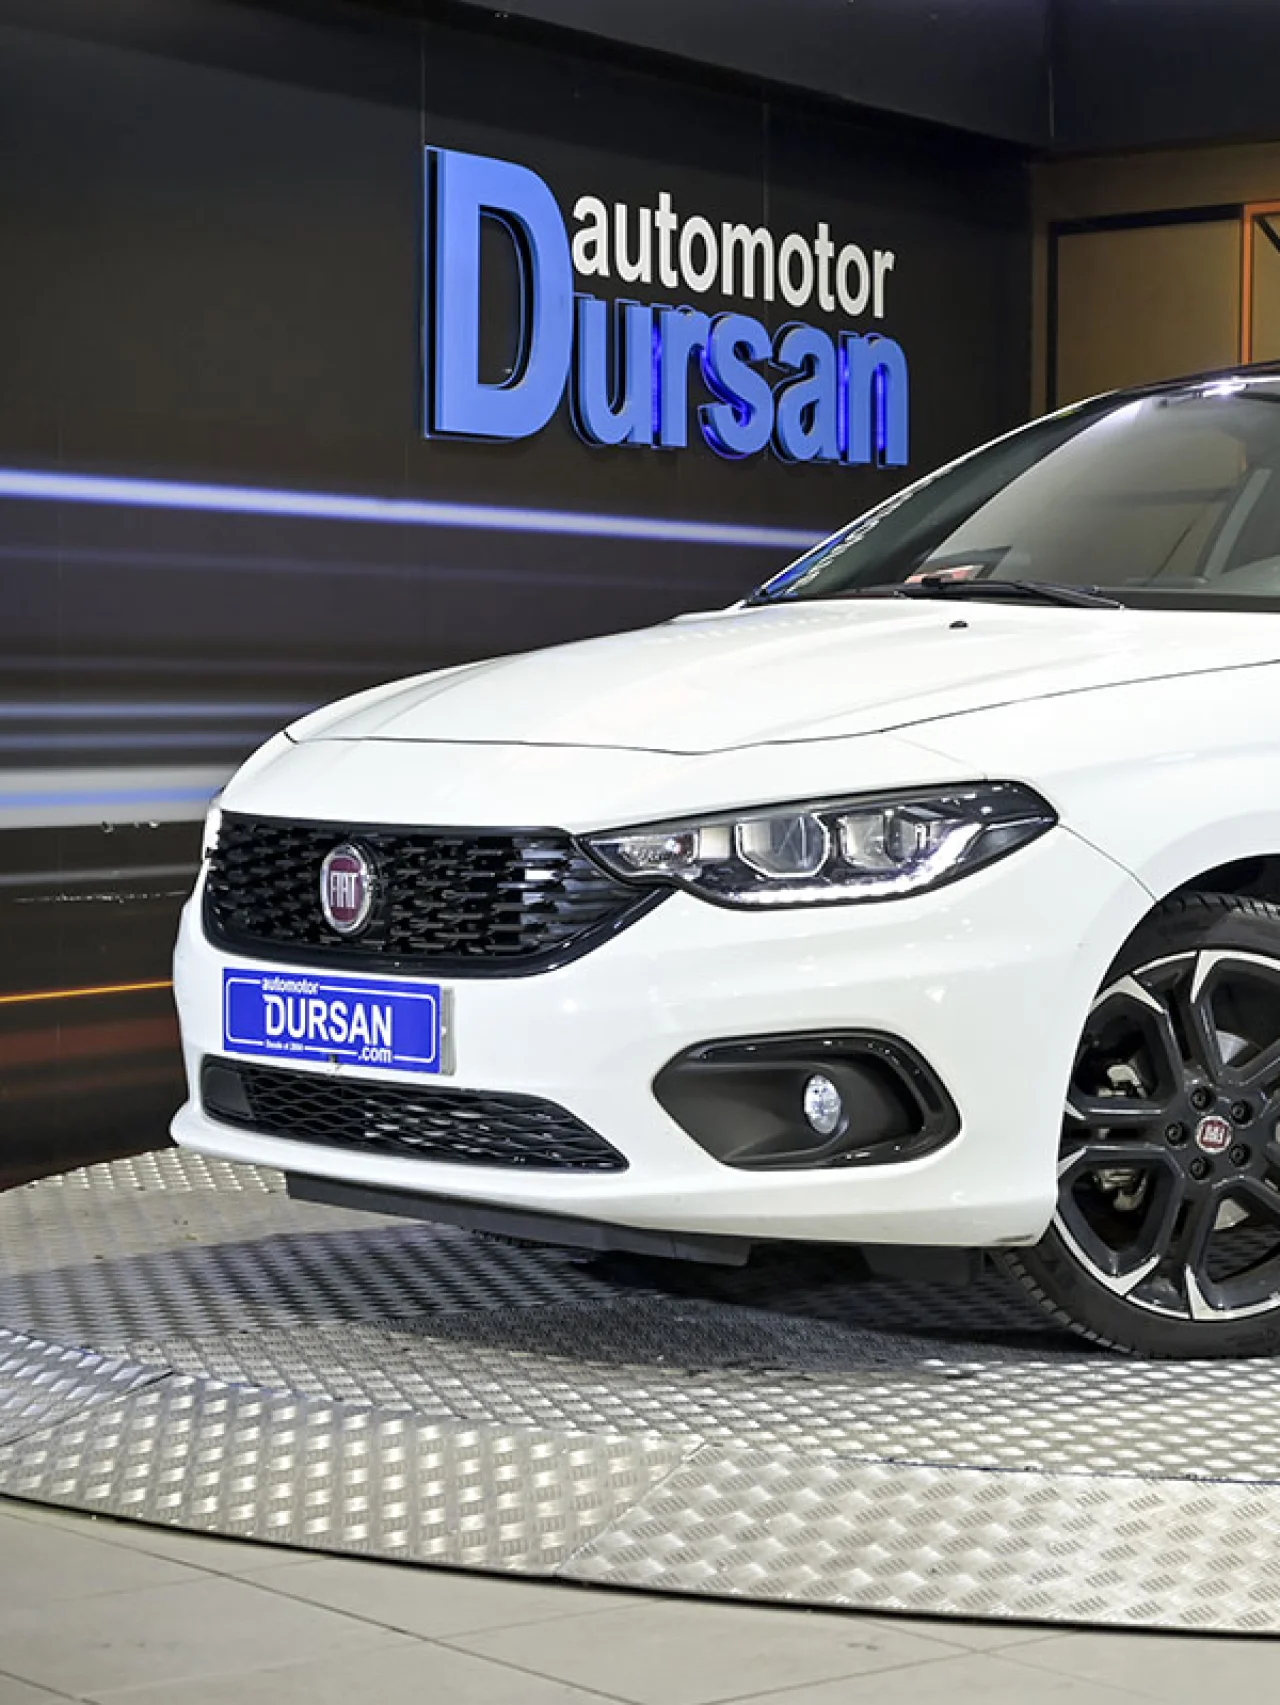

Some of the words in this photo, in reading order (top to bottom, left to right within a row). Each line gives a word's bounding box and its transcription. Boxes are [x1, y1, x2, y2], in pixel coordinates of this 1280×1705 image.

[571, 191, 895, 318] automotor
[425, 145, 908, 467] Dursan
[330, 871, 359, 909] FIAT
[262, 976, 320, 995] automotor
[262, 994, 393, 1047] DURSAN
[358, 1047, 393, 1063] .com
